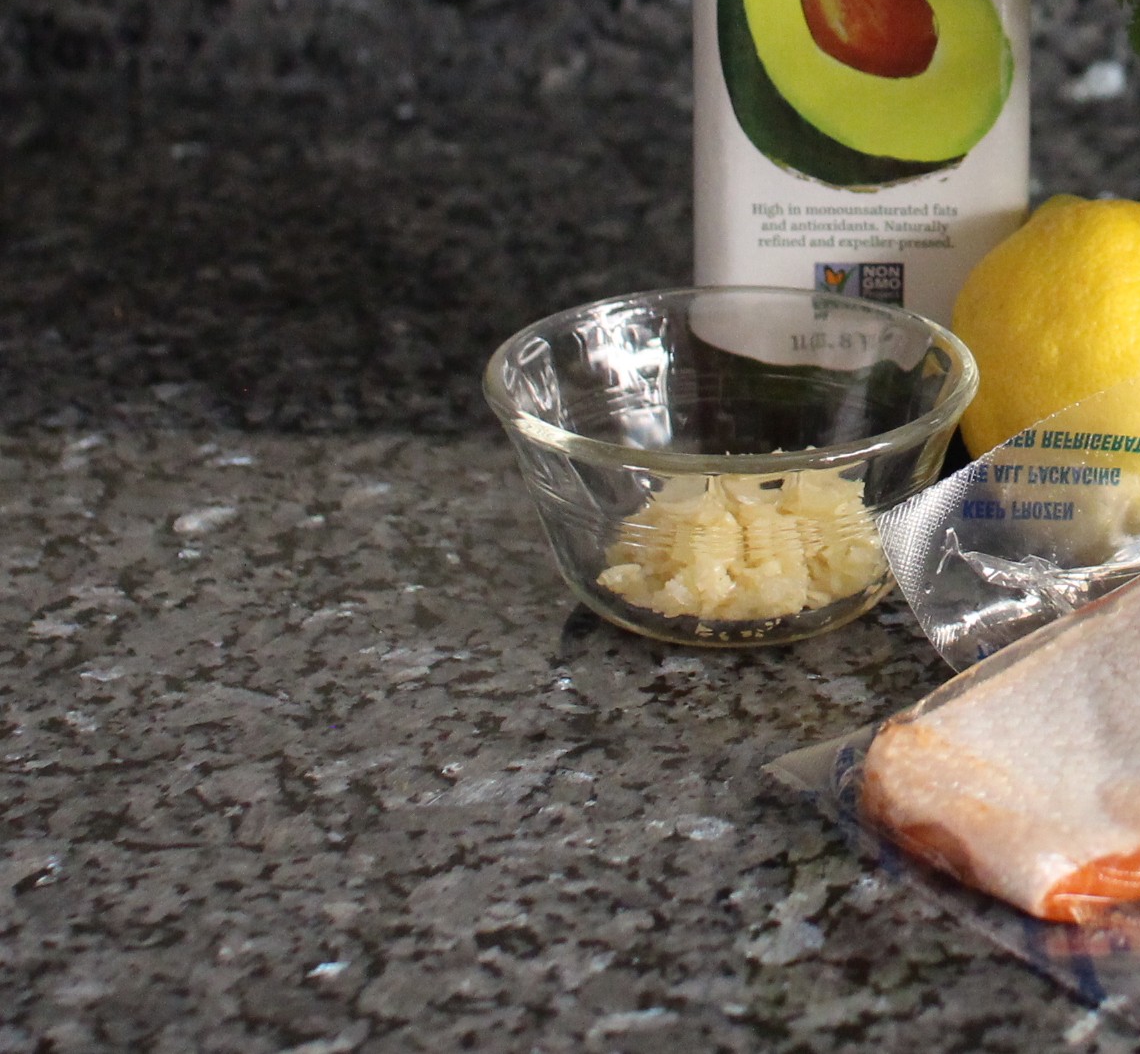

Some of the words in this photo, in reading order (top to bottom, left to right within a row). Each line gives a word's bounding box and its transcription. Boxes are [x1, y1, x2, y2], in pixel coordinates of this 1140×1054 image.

[752, 203, 784, 218] High
[788, 204, 801, 216] in
[805, 204, 928, 216] monounsaturated
[933, 204, 959, 216] fats
[761, 220, 786, 232] and
[790, 220, 880, 232] antioxidants.
[884, 221, 949, 235] Naturally
[758, 236, 806, 247] refined
[809, 236, 835, 247] and
[863, 266, 899, 277] NON
[863, 277, 901, 289] GMO
